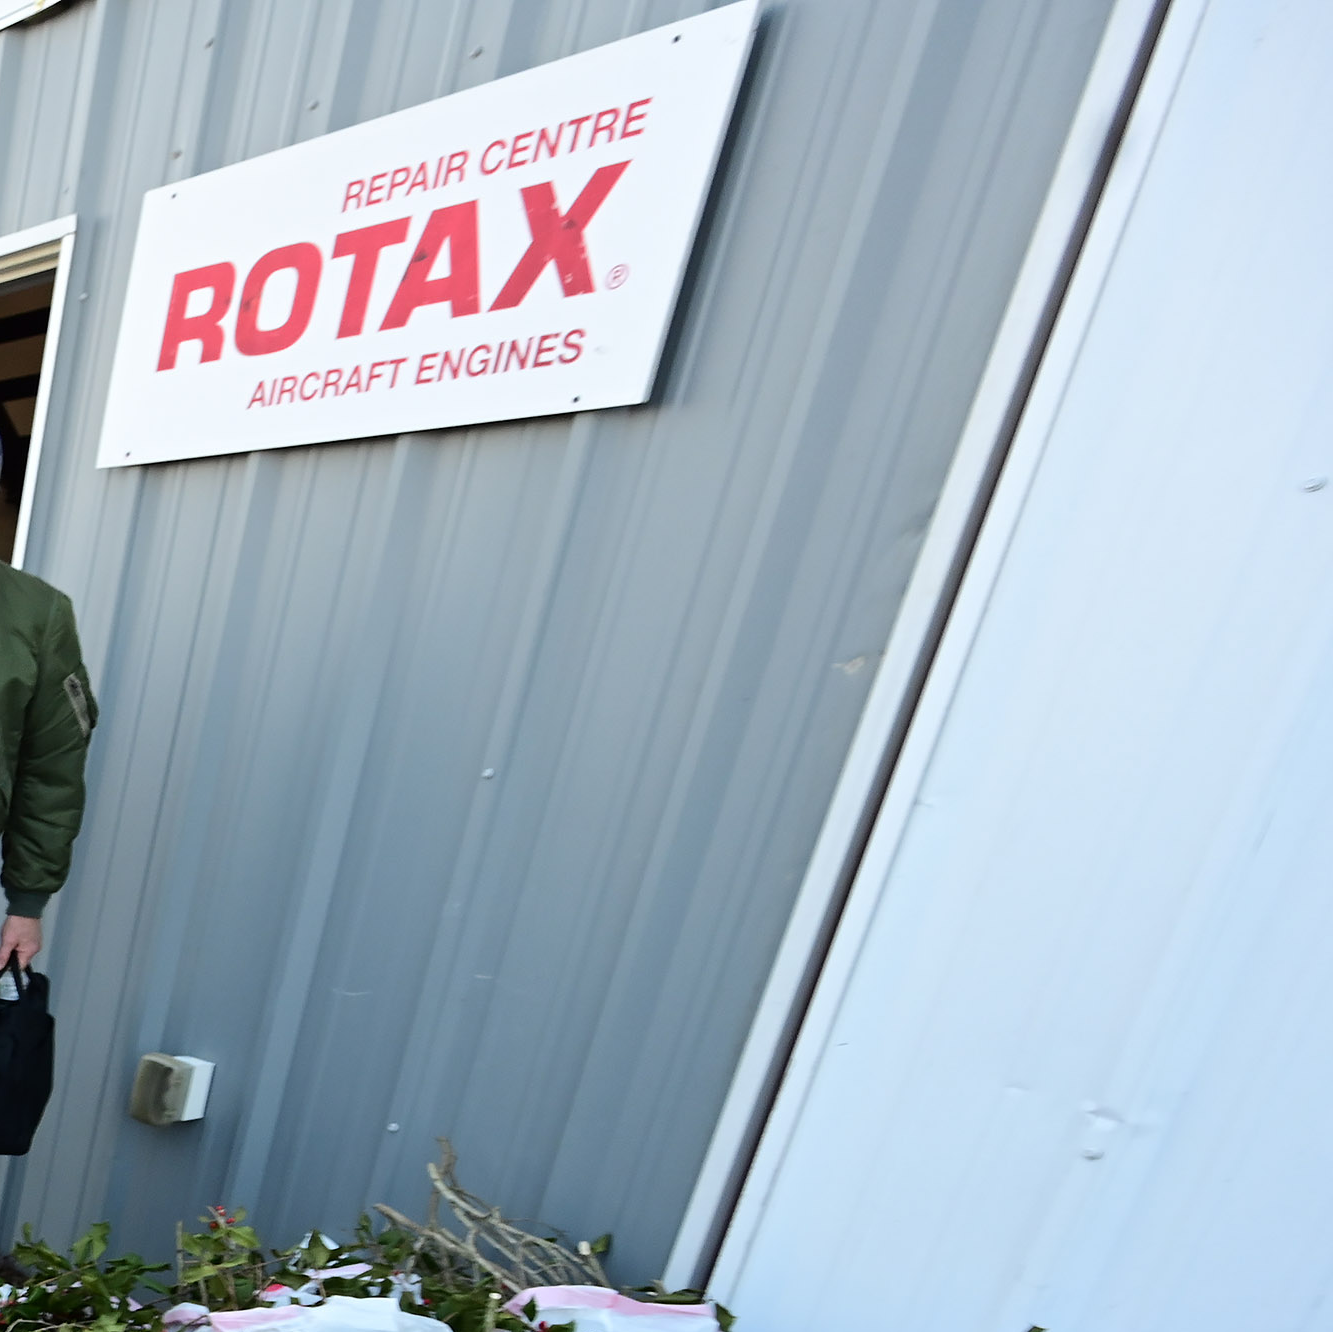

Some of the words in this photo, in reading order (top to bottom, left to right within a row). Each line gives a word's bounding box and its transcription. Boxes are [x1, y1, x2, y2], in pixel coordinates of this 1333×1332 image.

[341, 150, 469, 213] REPAIR
[480, 97, 653, 176] CENTRE
[156, 160, 632, 372] ROTAX
[247, 357, 408, 410] AIRCRAFT
[414, 329, 586, 386] ENGINES
